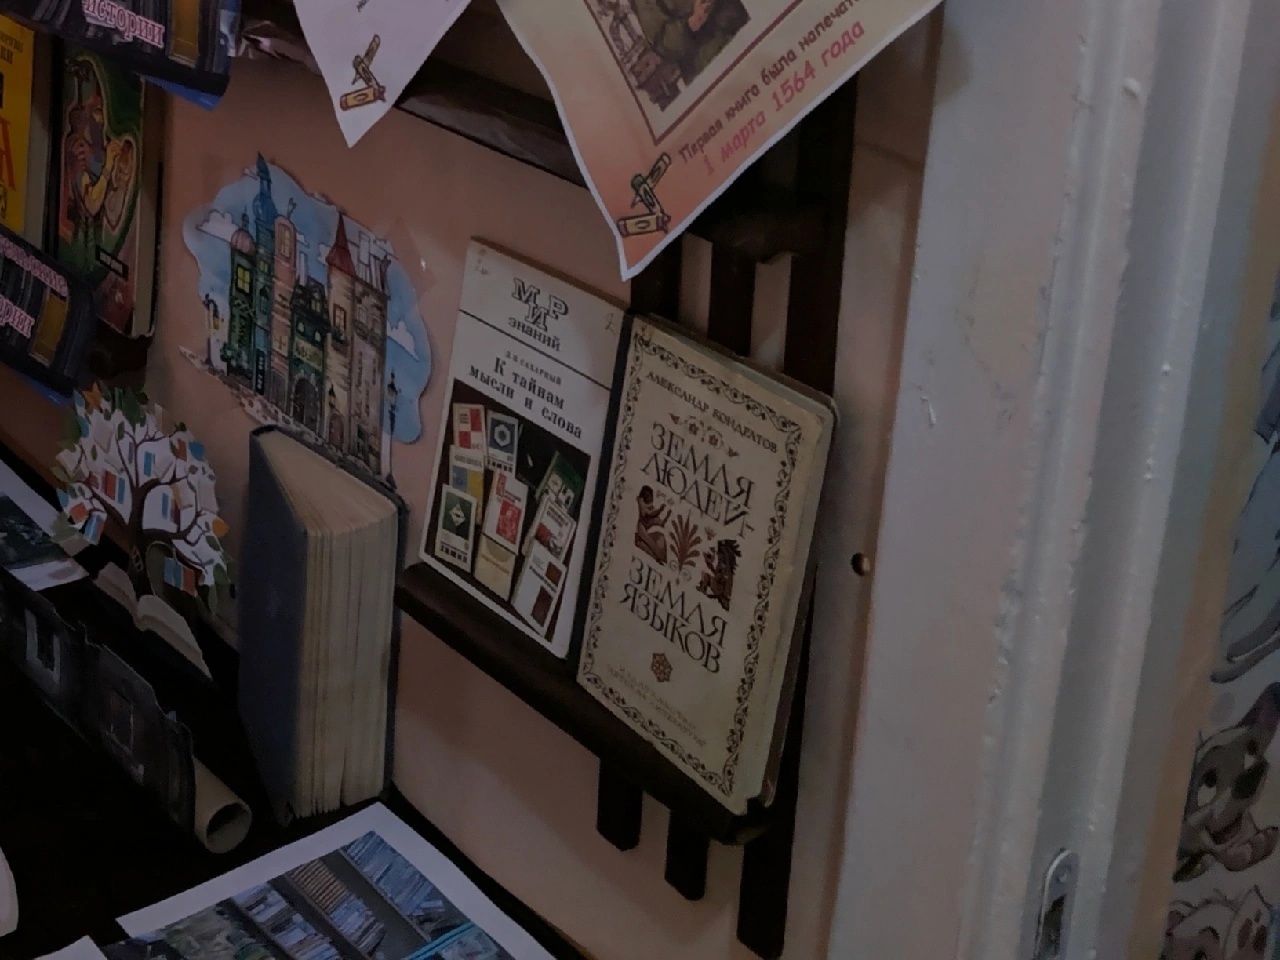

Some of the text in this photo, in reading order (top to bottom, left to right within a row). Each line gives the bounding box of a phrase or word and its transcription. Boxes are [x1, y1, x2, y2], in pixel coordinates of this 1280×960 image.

[678, 119, 723, 164] Первая
[725, 83, 760, 123] книга
[761, 49, 797, 86] была
[703, 21, 865, 176] 1 марта 1564 года
[508, 316, 561, 352] знаний
[468, 365, 583, 439] мысли и слова
[493, 357, 566, 411] К тайнам
[646, 369, 778, 454] АЛЕКСАНДР КОНДРАТОВ
[650, 423, 755, 510] ЗЕМЛЯ
[620, 582, 722, 674] ЯЗЫКОВ
[629, 556, 728, 651] ЗЕМЛЯ
